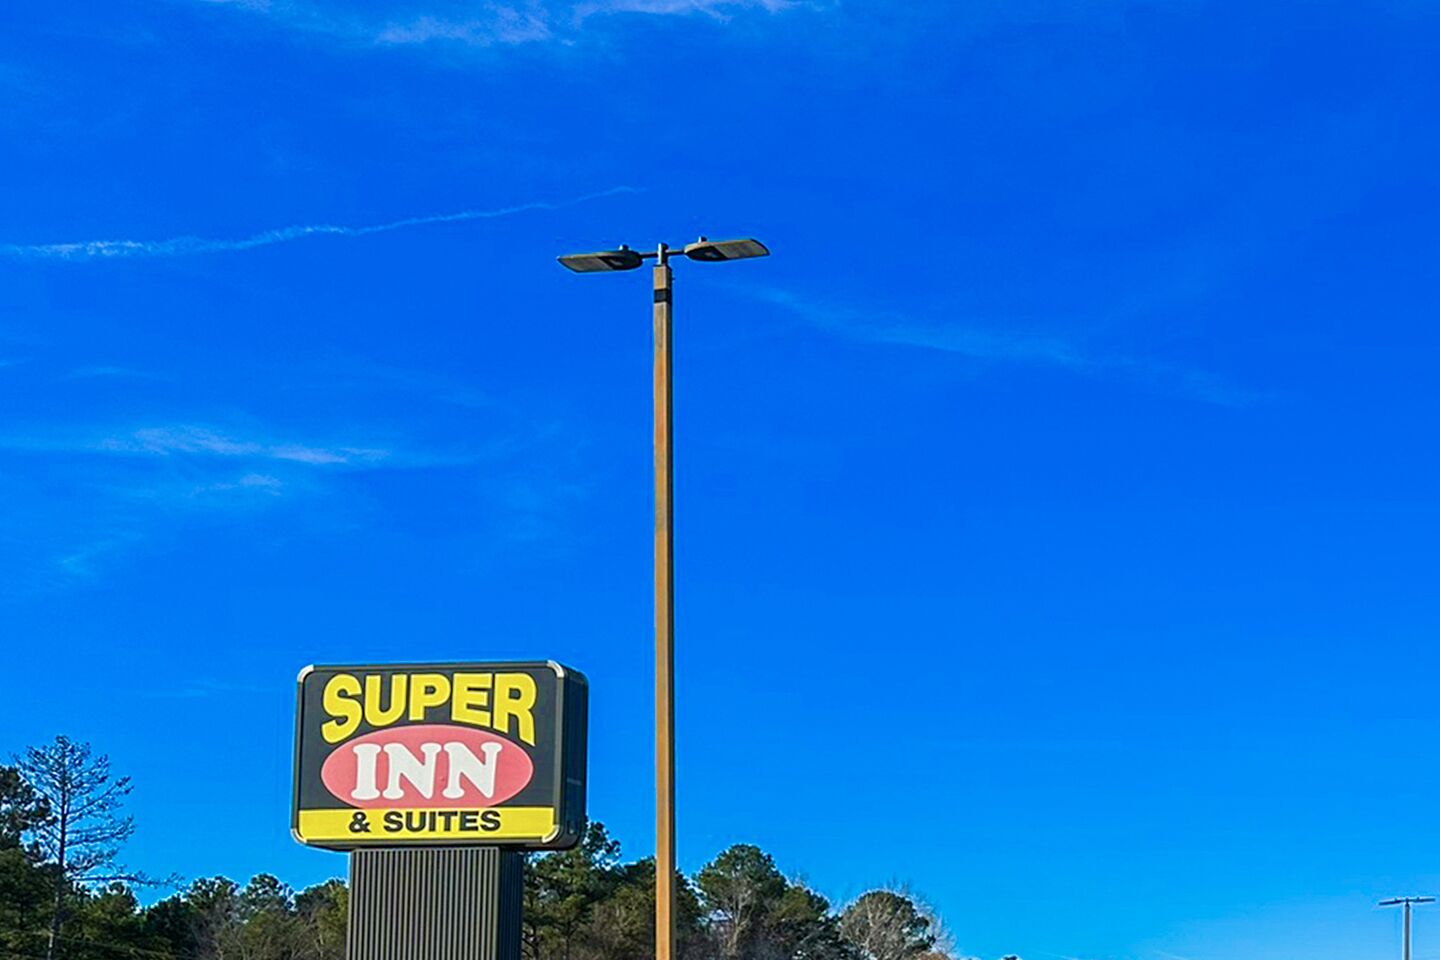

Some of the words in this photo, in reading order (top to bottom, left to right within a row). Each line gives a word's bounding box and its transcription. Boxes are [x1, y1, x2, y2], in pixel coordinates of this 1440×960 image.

[321, 673, 536, 746] SUPER
[351, 742, 502, 799] INN
[349, 811, 371, 833] &
[383, 810, 501, 833] SUITES
